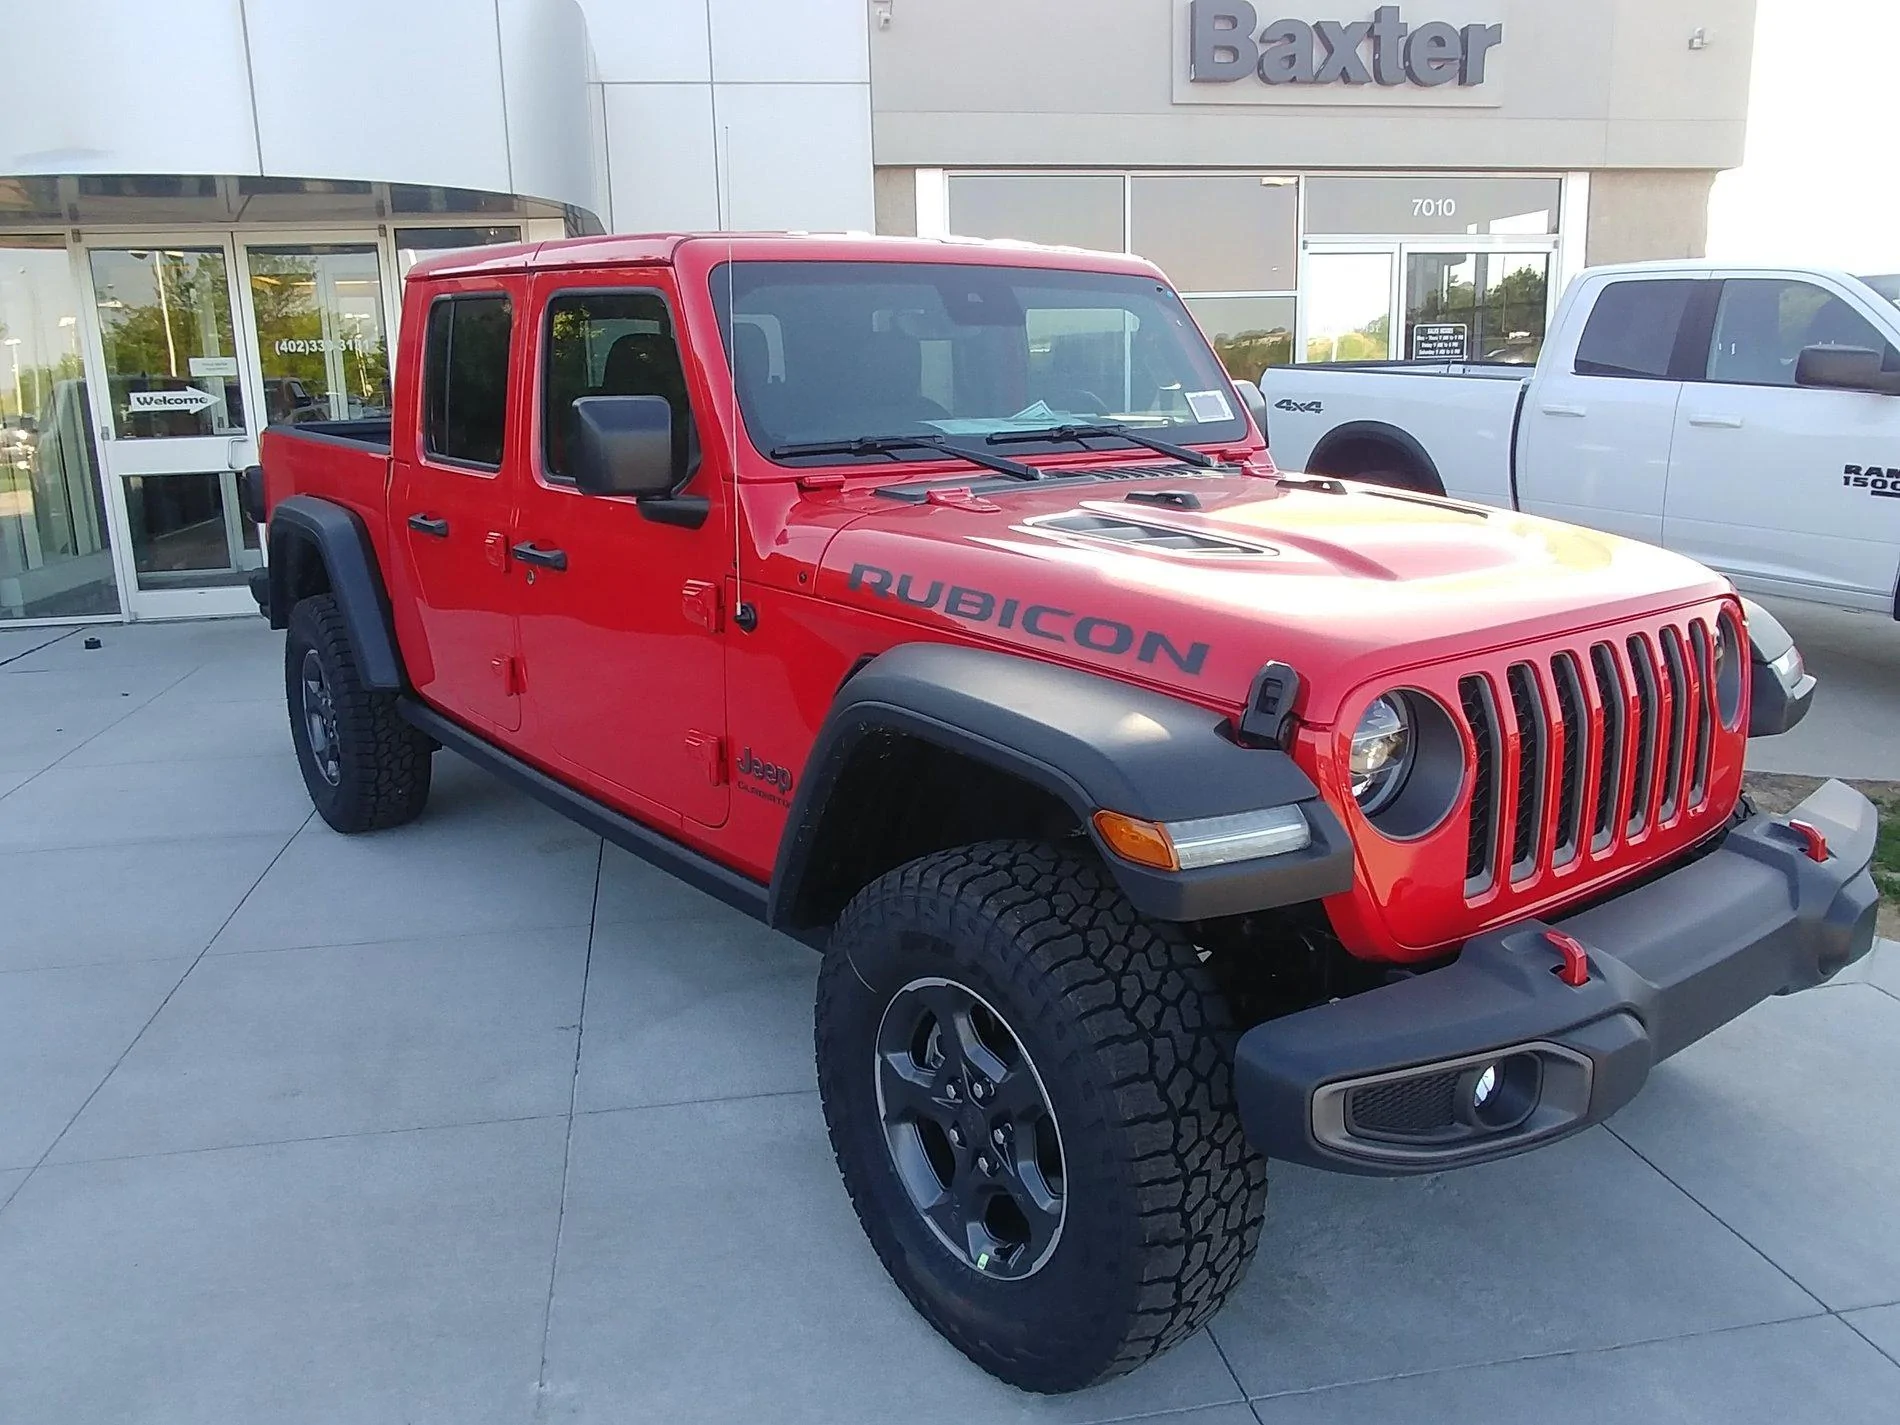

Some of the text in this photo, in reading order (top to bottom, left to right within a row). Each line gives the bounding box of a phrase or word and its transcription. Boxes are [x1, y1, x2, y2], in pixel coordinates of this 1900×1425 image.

[1190, 0, 1502, 86] Baxter
[1411, 199, 1456, 216] 7010
[136, 395, 208, 406] Welcome
[1274, 399, 1324, 414] 4x4
[848, 563, 1210, 676] RUBICON
[736, 746, 794, 795] Jeep
